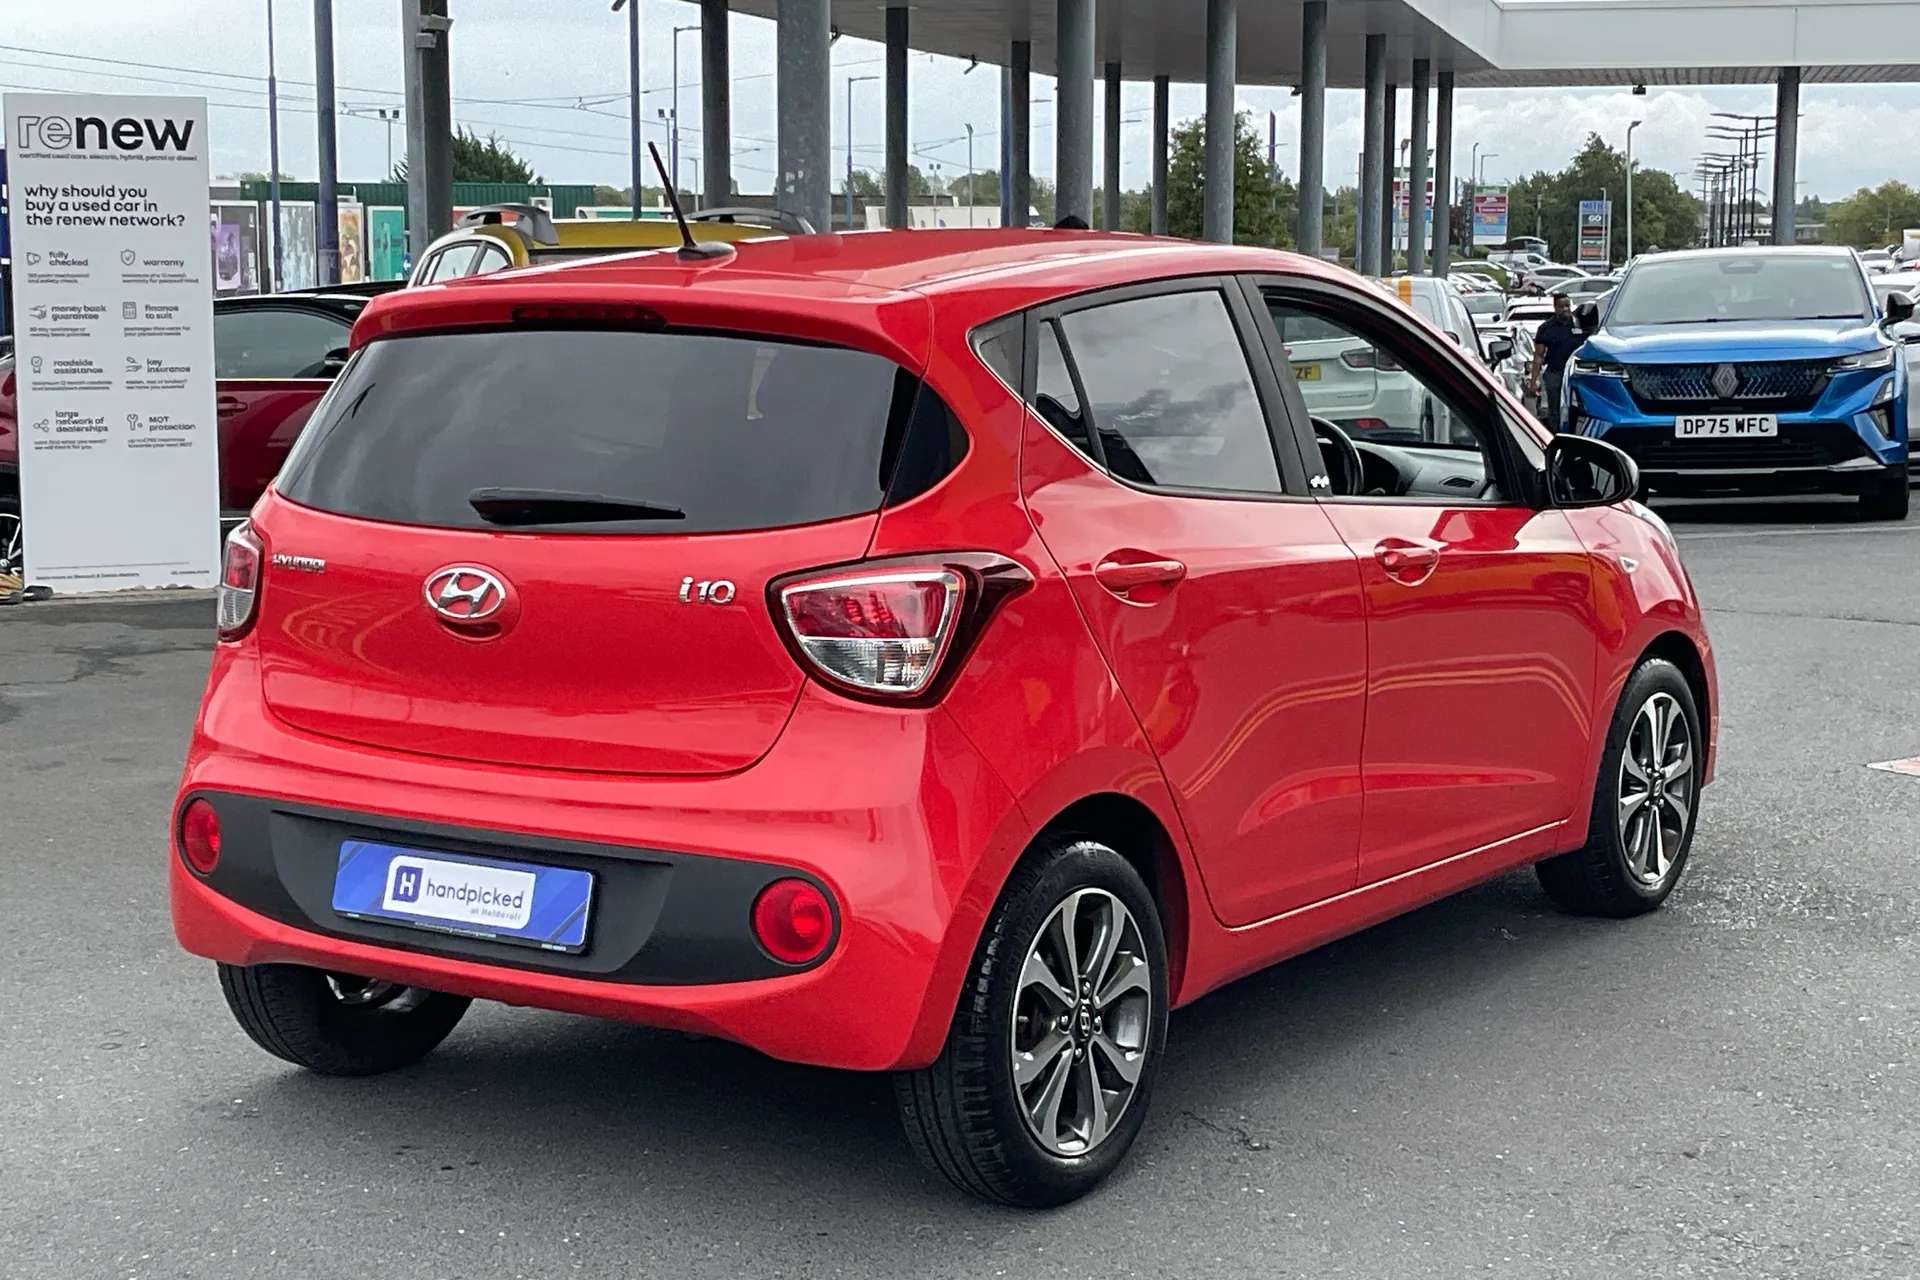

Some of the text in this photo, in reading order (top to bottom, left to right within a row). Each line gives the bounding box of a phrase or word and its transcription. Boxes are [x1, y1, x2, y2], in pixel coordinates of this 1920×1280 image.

[18, 115, 195, 151] renew
[24, 185, 148, 200] why should you
[25, 199, 158, 213] buy a used car in
[26, 213, 185, 226] the renew network?
[49, 251, 69, 260] fully
[49, 258, 88, 266] checked
[143, 259, 184, 268] warranty
[51, 304, 107, 314] money back
[145, 304, 179, 312] finance
[51, 313, 99, 321] guarantee
[54, 359, 93, 367] roadside
[147, 358, 163, 367] key
[54, 366, 103, 374] assistance
[147, 365, 191, 373] insurance
[55, 410, 79, 419] large
[94, 417, 105, 425] of
[149, 416, 170, 424] MOT
[56, 424, 109, 433] dealerships
[149, 423, 196, 433] protection
[1683, 417, 1769, 435] DP75 WFC
[680, 576, 736, 603] i10
[426, 878, 525, 909] handpicked
